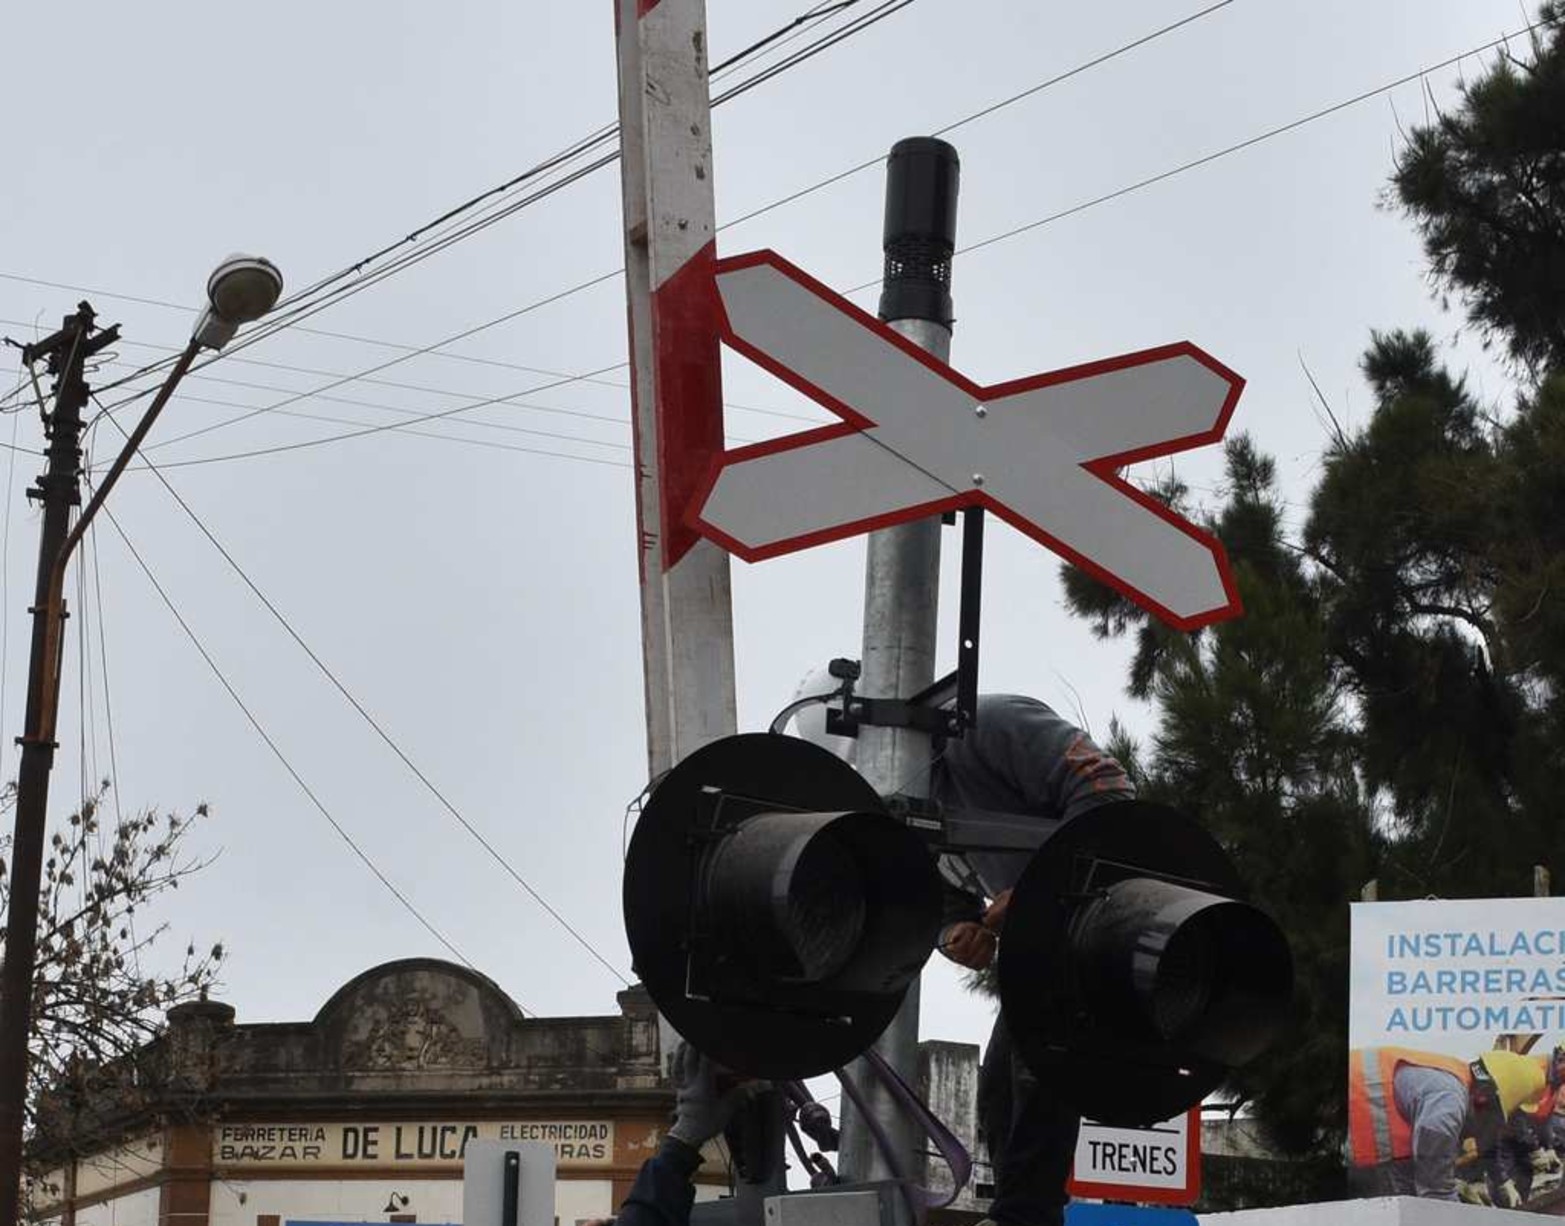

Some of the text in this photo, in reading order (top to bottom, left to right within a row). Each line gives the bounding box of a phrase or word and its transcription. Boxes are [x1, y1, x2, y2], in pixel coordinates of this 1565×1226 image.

[342, 1127, 380, 1159] DE
[500, 1125, 608, 1140] ELECTRICIDAD
[221, 1145, 321, 1160] BAZAR
[1088, 1141, 1177, 1175] TRENES
